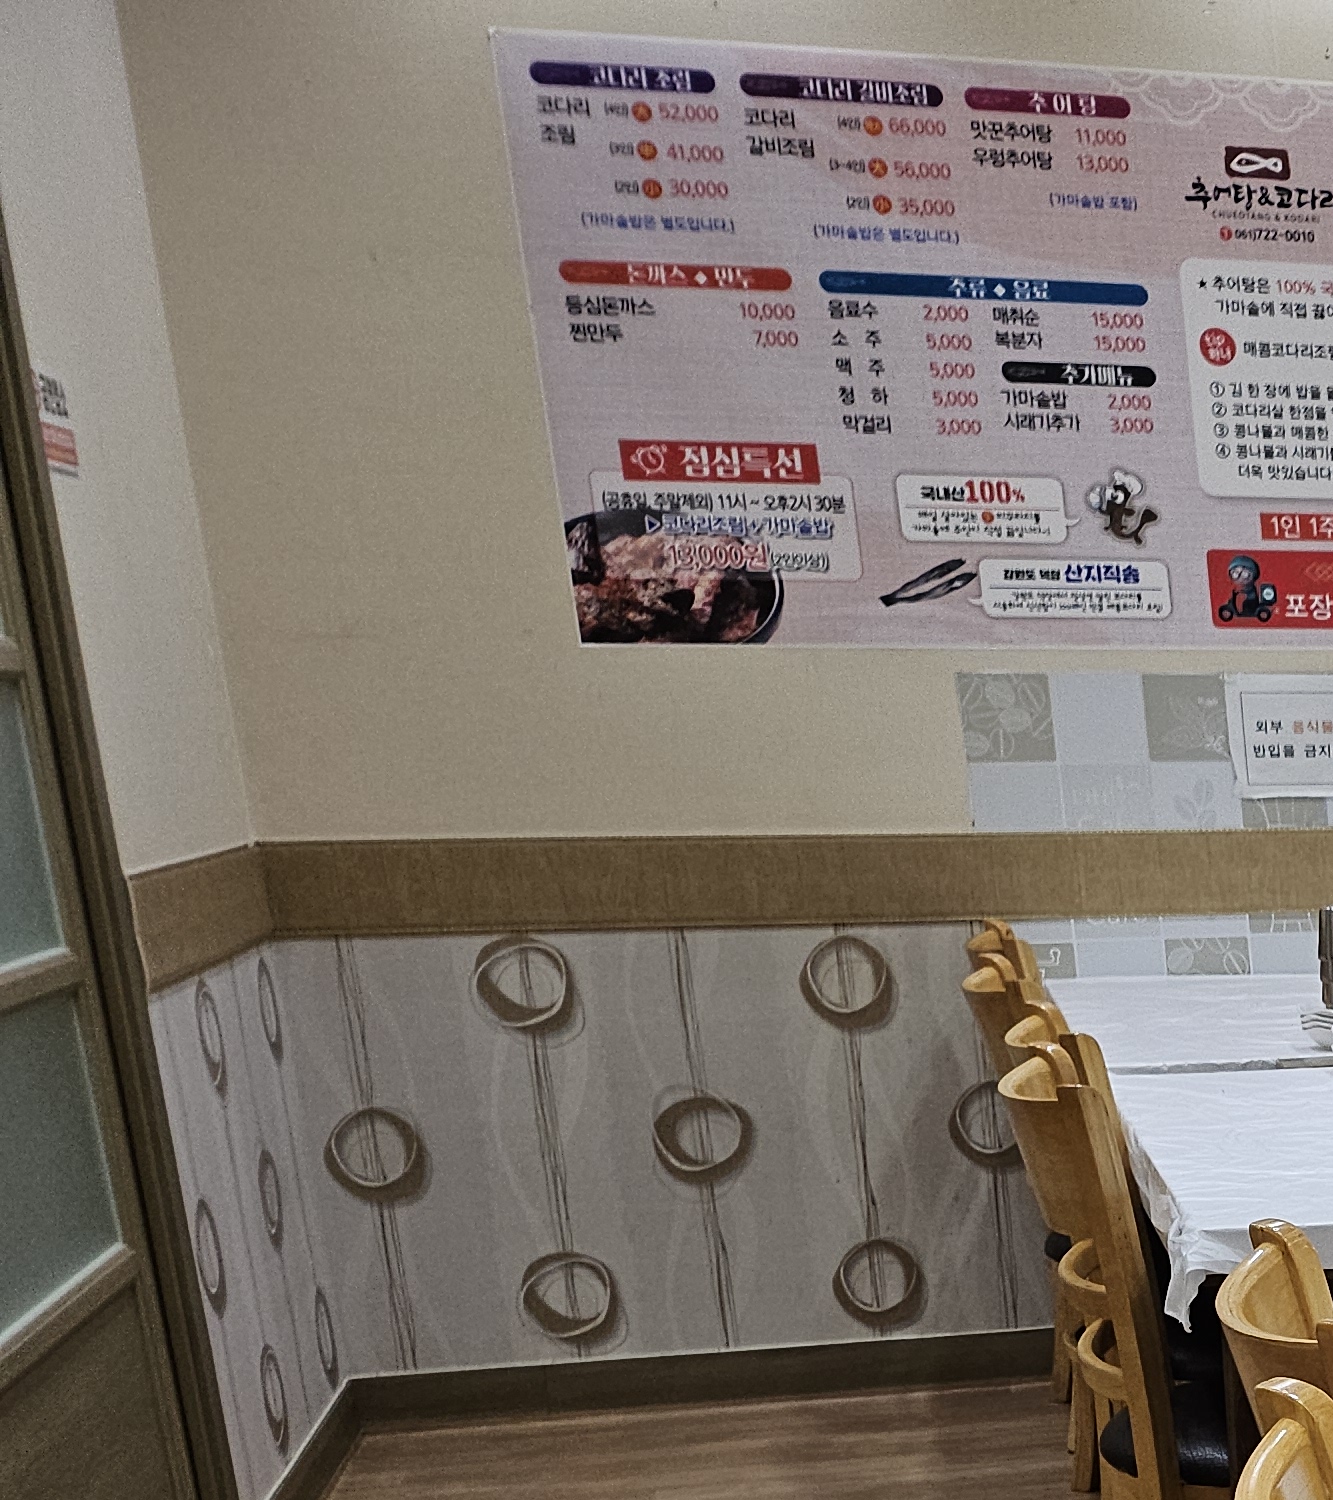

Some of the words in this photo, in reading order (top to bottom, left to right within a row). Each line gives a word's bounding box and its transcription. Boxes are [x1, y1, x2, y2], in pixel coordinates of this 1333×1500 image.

[536, 95, 591, 117] 코다리
[658, 102, 719, 122] 52,000
[744, 107, 796, 129] 코다리
[888, 117, 947, 137] 66,000
[540, 123, 576, 145] 조림
[970, 119, 1052, 143] 맛꾼추어탕
[1075, 127, 1127, 147] 11,000
[666, 142, 724, 163] 41,000
[746, 135, 815, 159] 갈비조림
[893, 160, 951, 180] 56,000
[971, 147, 1053, 171] 우렁추어탕
[1076, 153, 1129, 174] 13,000
[669, 179, 729, 200] 30,000
[898, 197, 955, 217] 35,000
[1234, 226, 1316, 243] 061)722-0010
[1212, 275, 1271, 295] 추어탕은
[1276, 279, 1316, 296] 100%
[565, 293, 656, 318] 등심돈까스
[740, 302, 796, 322] 10,000
[828, 299, 879, 320] 음료수
[923, 303, 969, 323] 2,000
[992, 305, 1040, 328] 매취순
[1092, 311, 1145, 330] 15,000
[1214, 299, 1275, 318] 가마솥에
[1280, 301, 1308, 319] 직접
[569, 322, 624, 344] 찐만두
[752, 329, 799, 348] 7,000
[926, 332, 973, 351] 5,000
[995, 329, 1043, 350] 복분자
[1094, 335, 1146, 353] 15,000
[929, 360, 976, 380] 5,000
[932, 389, 979, 408] 5,000
[1000, 388, 1069, 410] 가마솥밥
[1108, 393, 1152, 412] 2,000
[842, 412, 892, 434] 막걸리
[937, 417, 982, 436] 3,000
[1003, 412, 1081, 433] 시래기추가
[1110, 417, 1154, 435] 3,000
[679, 443, 805, 480] 점심특선
[1238, 464, 1263, 480] 더욱
[1270, 514, 1301, 539] 1인
[1065, 563, 1141, 584] 산지직송
[1285, 593, 1333, 621] 포장
[1255, 719, 1283, 735] 외부
[1253, 743, 1295, 758] 반입을
